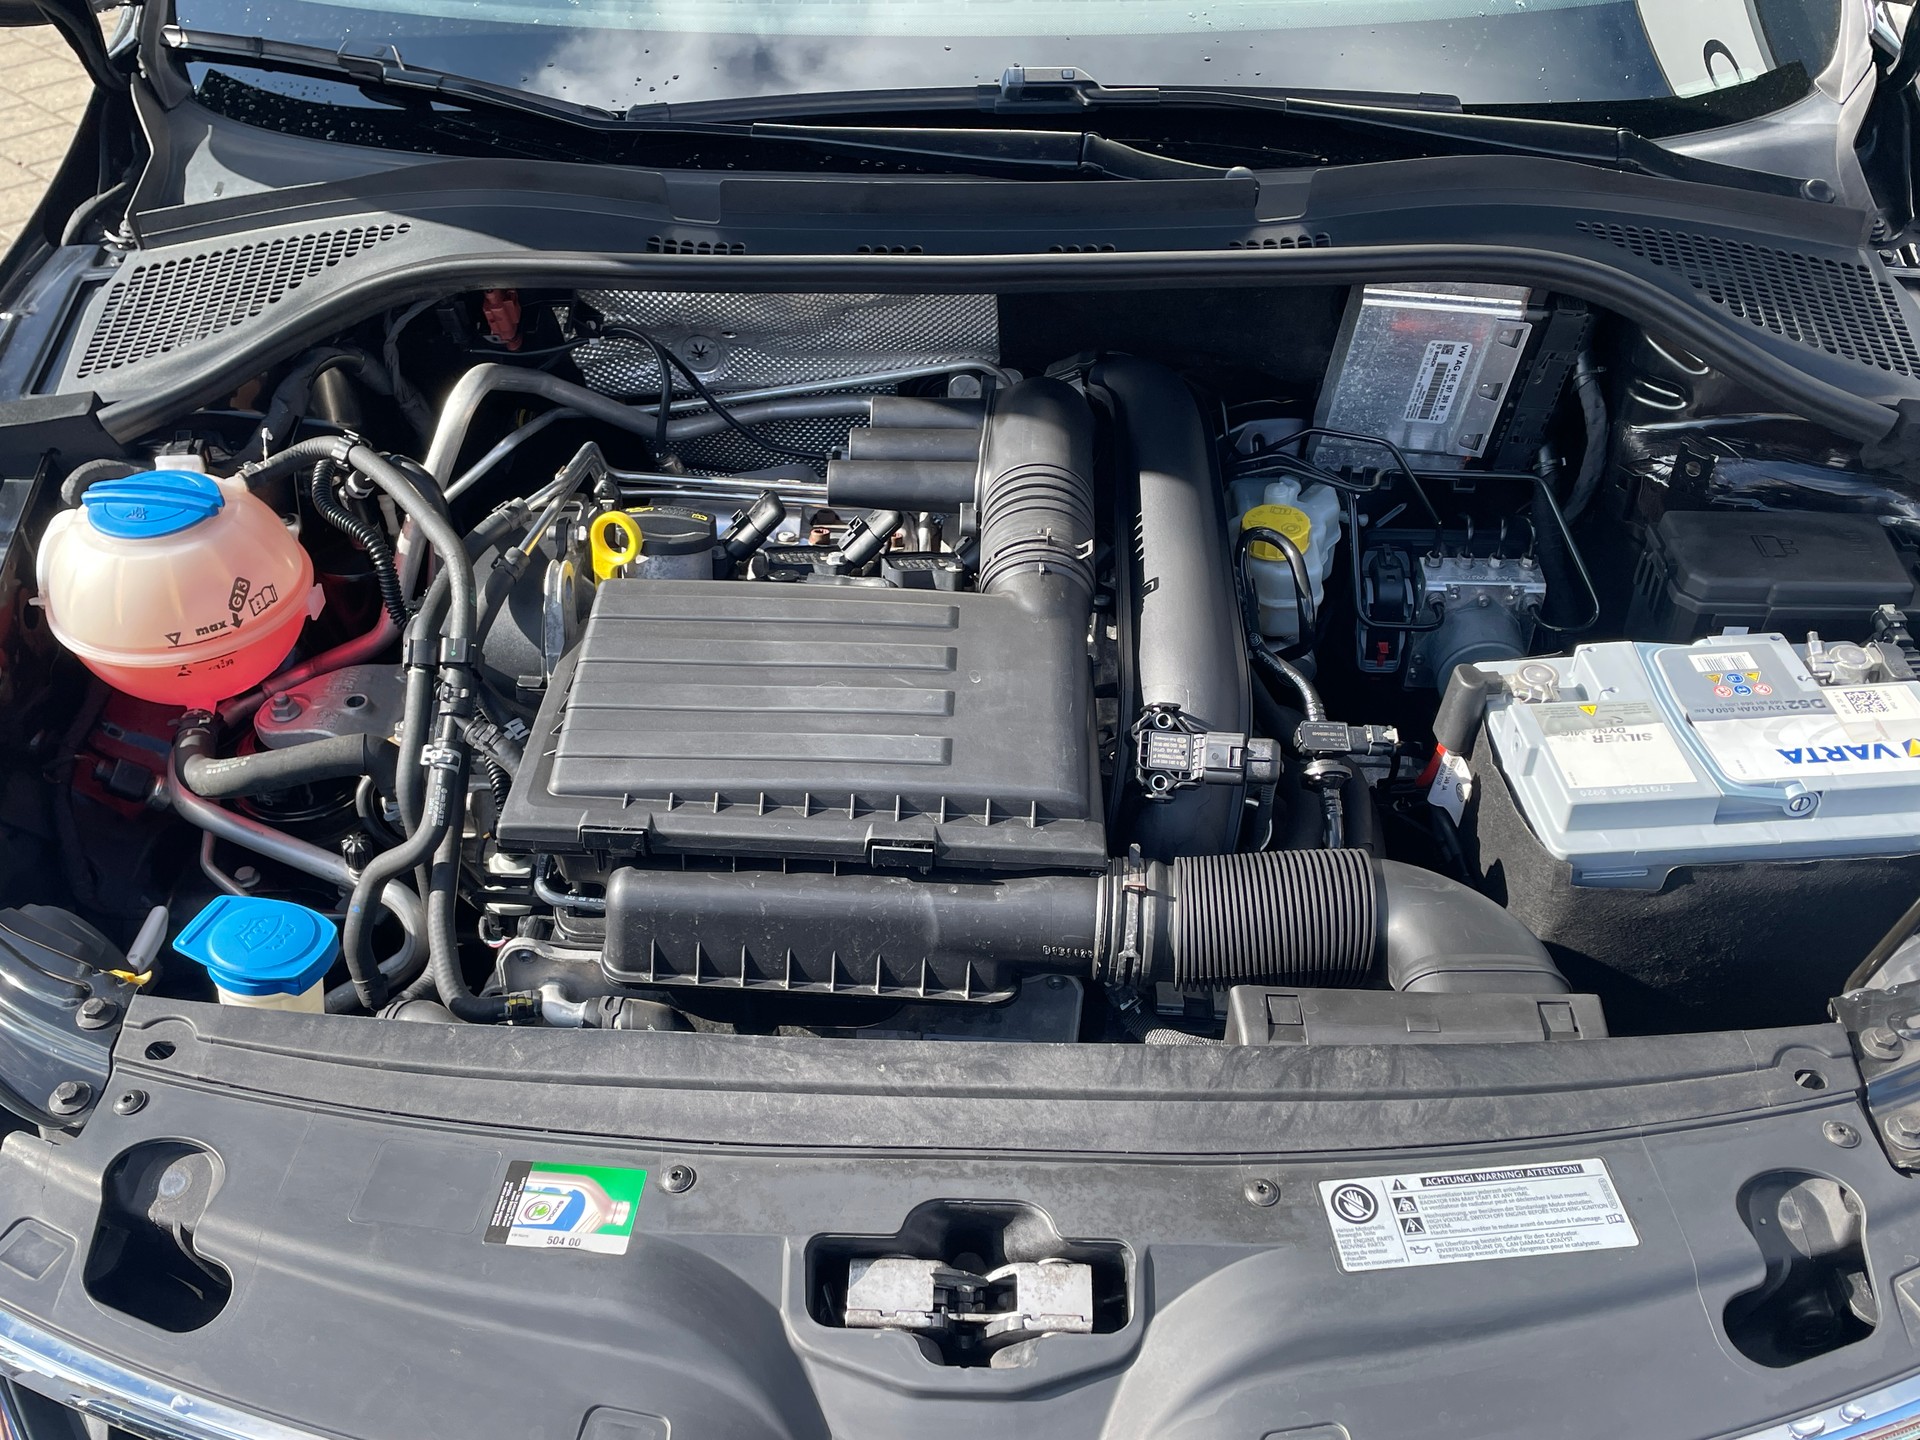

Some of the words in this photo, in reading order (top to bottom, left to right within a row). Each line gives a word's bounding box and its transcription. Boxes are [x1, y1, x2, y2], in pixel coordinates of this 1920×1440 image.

[1458, 345, 1469, 358] VW
[1431, 351, 1440, 368] BOSCH
[1453, 360, 1463, 372] AG
[232, 581, 247, 608] G13
[196, 620, 228, 636] max
[1785, 699, 1826, 709] D52
[1592, 732, 1653, 743] SILVER
[1776, 743, 1902, 764] VARTA
[1424, 1175, 1475, 1186] ACHTUNG!
[1475, 1170, 1526, 1181] WARNING!
[1526, 1166, 1581, 1177] ATTENTION!
[546, 1236, 566, 1245] 504
[568, 1238, 581, 1247] 00
